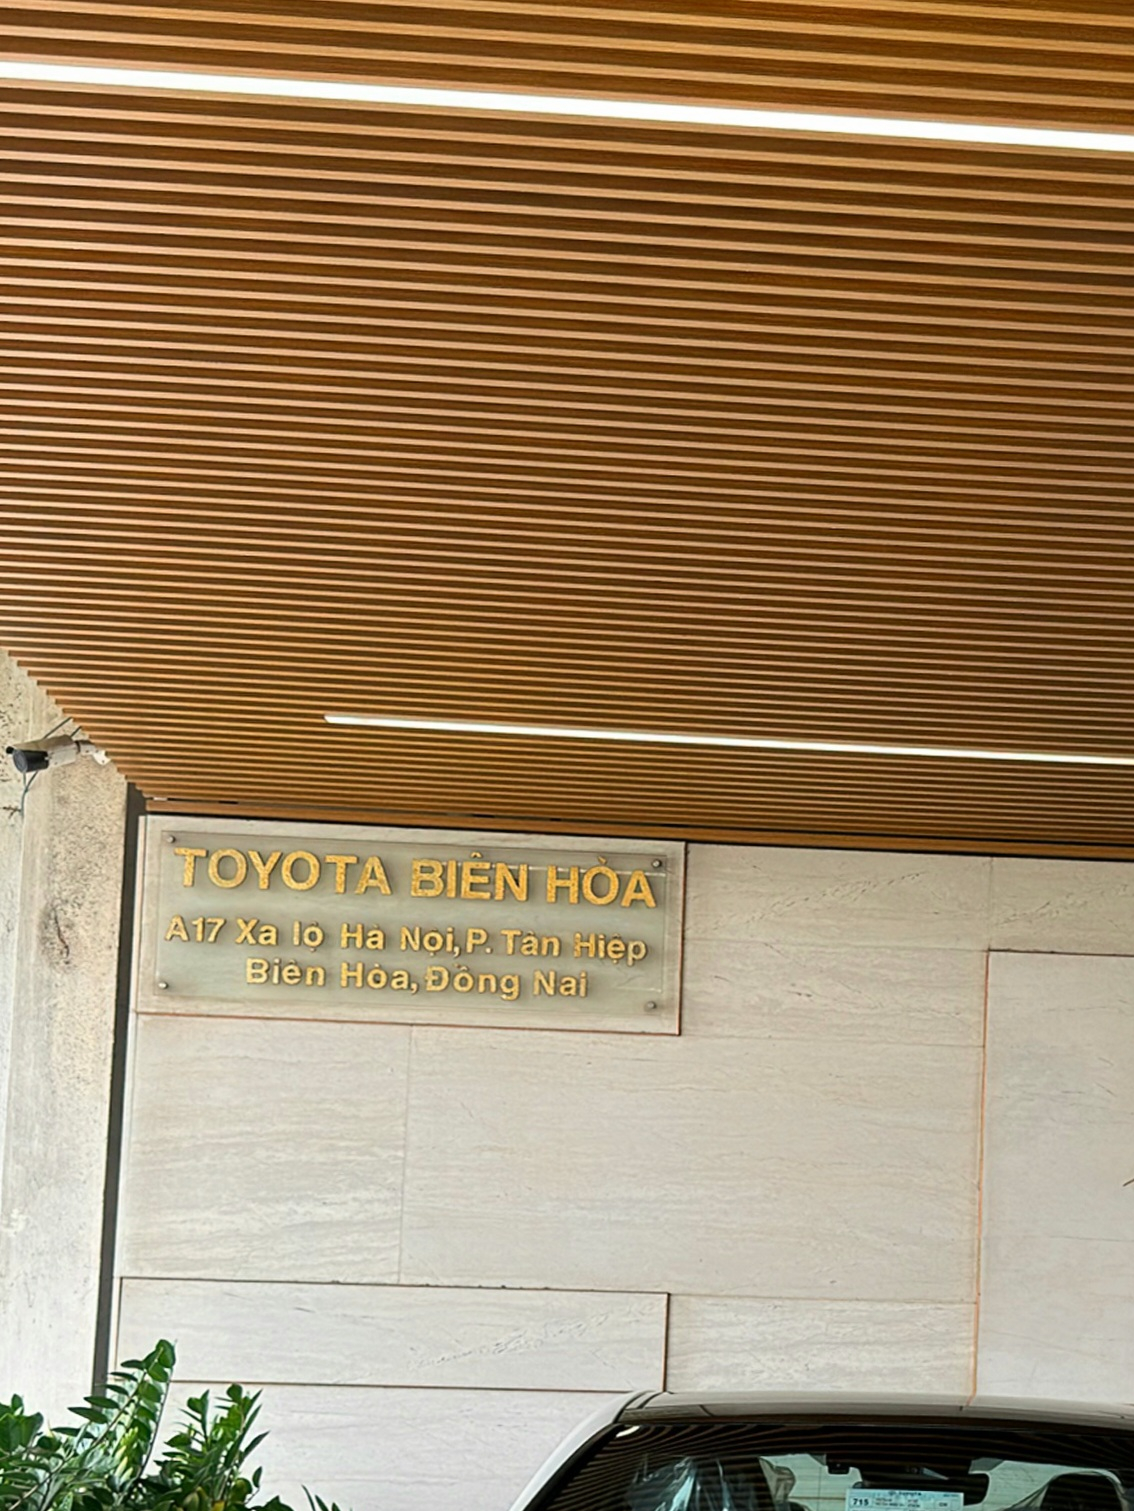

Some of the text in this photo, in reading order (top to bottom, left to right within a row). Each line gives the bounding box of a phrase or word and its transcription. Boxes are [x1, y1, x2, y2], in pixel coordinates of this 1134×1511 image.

[174, 847, 657, 909] TOYOTA BIÊN HÒA
[164, 914, 226, 943] A17
[234, 917, 279, 947] Xa
[340, 922, 386, 951] Hà
[500, 929, 561, 957] Tân
[573, 932, 648, 967] Hiệp
[246, 957, 326, 987] Biên
[533, 968, 589, 998] Nai
